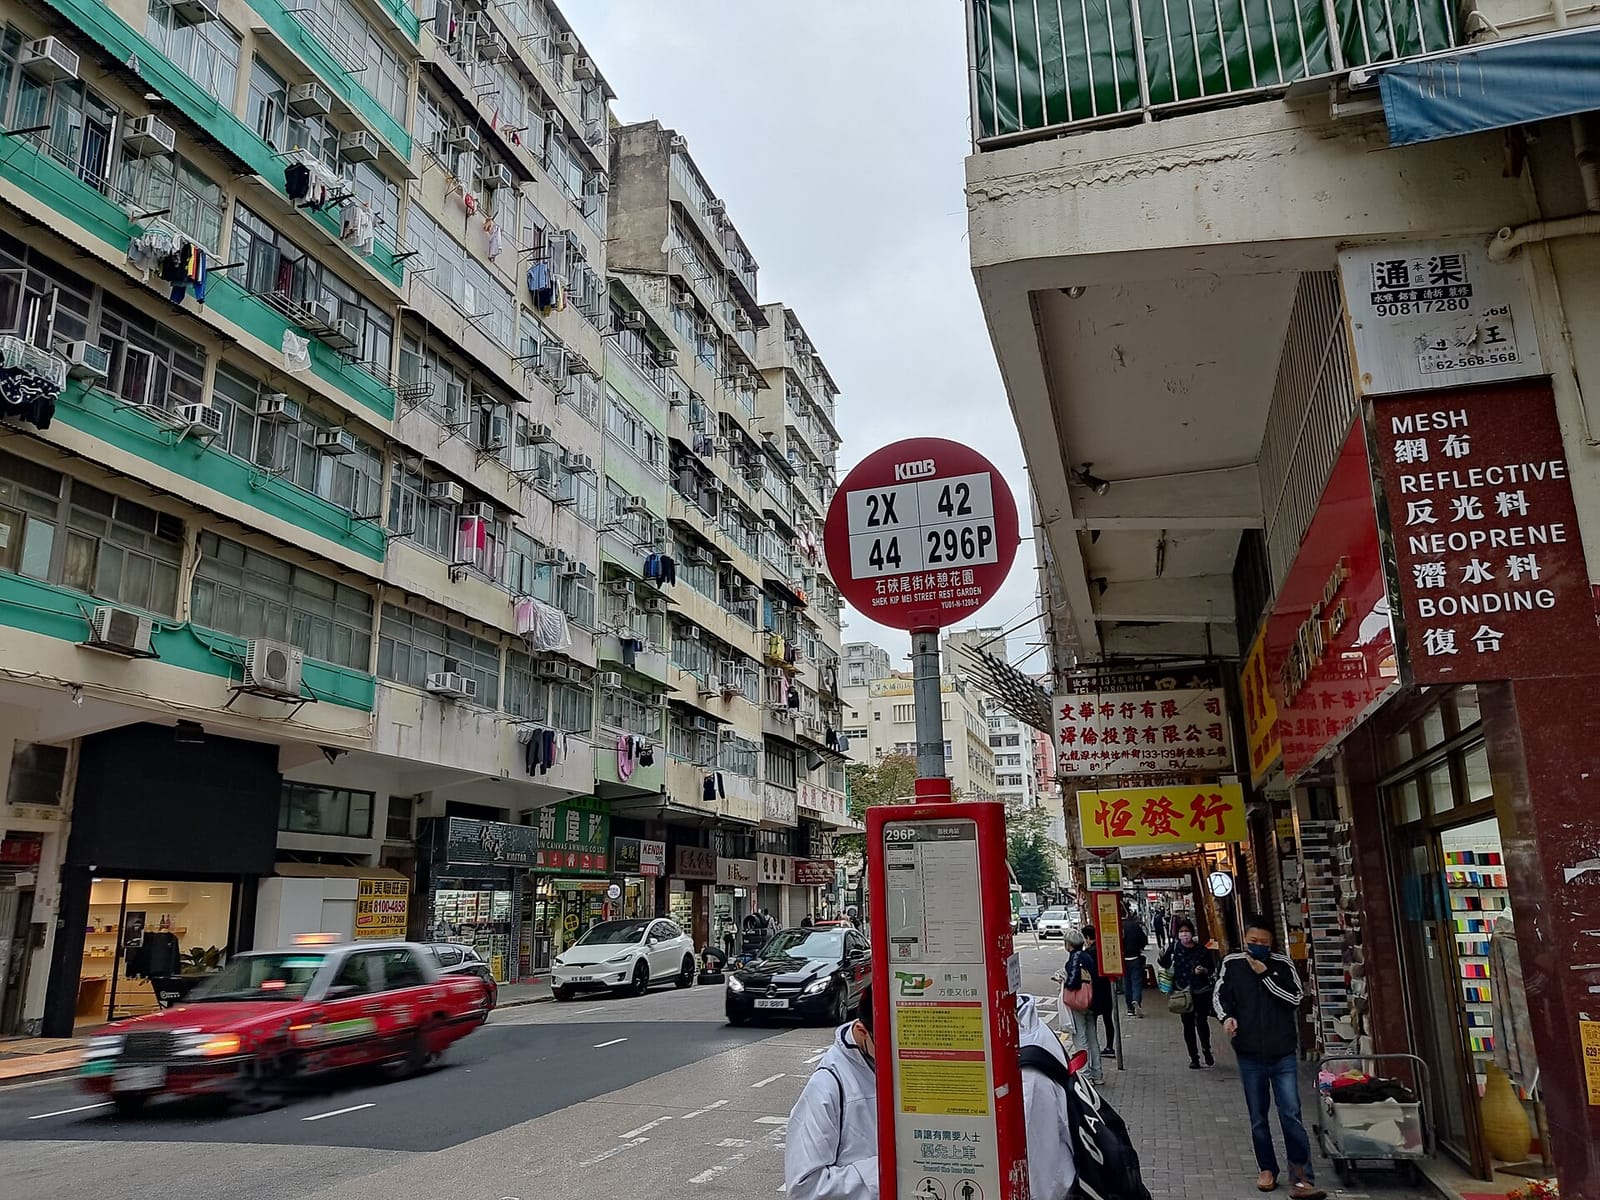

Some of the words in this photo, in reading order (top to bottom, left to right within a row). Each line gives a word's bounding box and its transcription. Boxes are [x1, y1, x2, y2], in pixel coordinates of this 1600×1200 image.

[1376, 298, 1470, 317] 90817280
[1391, 409, 1469, 434] MESH
[1393, 434, 1472, 464] 網布
[894, 458, 937, 481] KMB
[1400, 460, 1566, 494] REFLECTIVE
[866, 492, 899, 528] 2X
[937, 483, 972, 518] 42
[1405, 490, 1531, 526] 反光料
[868, 536, 901, 571] 44
[927, 525, 992, 564] 296P
[1409, 523, 1567, 555] NEOPRENE
[875, 568, 975, 595] 石硤尾街休憩花園
[1412, 554, 1542, 589] 潛水料
[872, 596, 888, 607] SHEK
[890, 595, 900, 605] KIP
[901, 594, 913, 604] MEI
[914, 591, 937, 602] STREET
[938, 589, 955, 599] REST
[956, 586, 982, 598] GARDEN
[1418, 589, 1557, 618] BONDING
[1422, 625, 1505, 657] 復合
[1059, 697, 1222, 722] 文華布行有限司
[1059, 722, 1225, 747] 澤倫投資有限公司
[1094, 793, 1233, 838] 恒發行
[885, 828, 916, 841] 296P
[642, 843, 664, 856] KENDA
[913, 1129, 981, 1143] 請讓有需要人士
[920, 1143, 977, 1161] 優先上車
